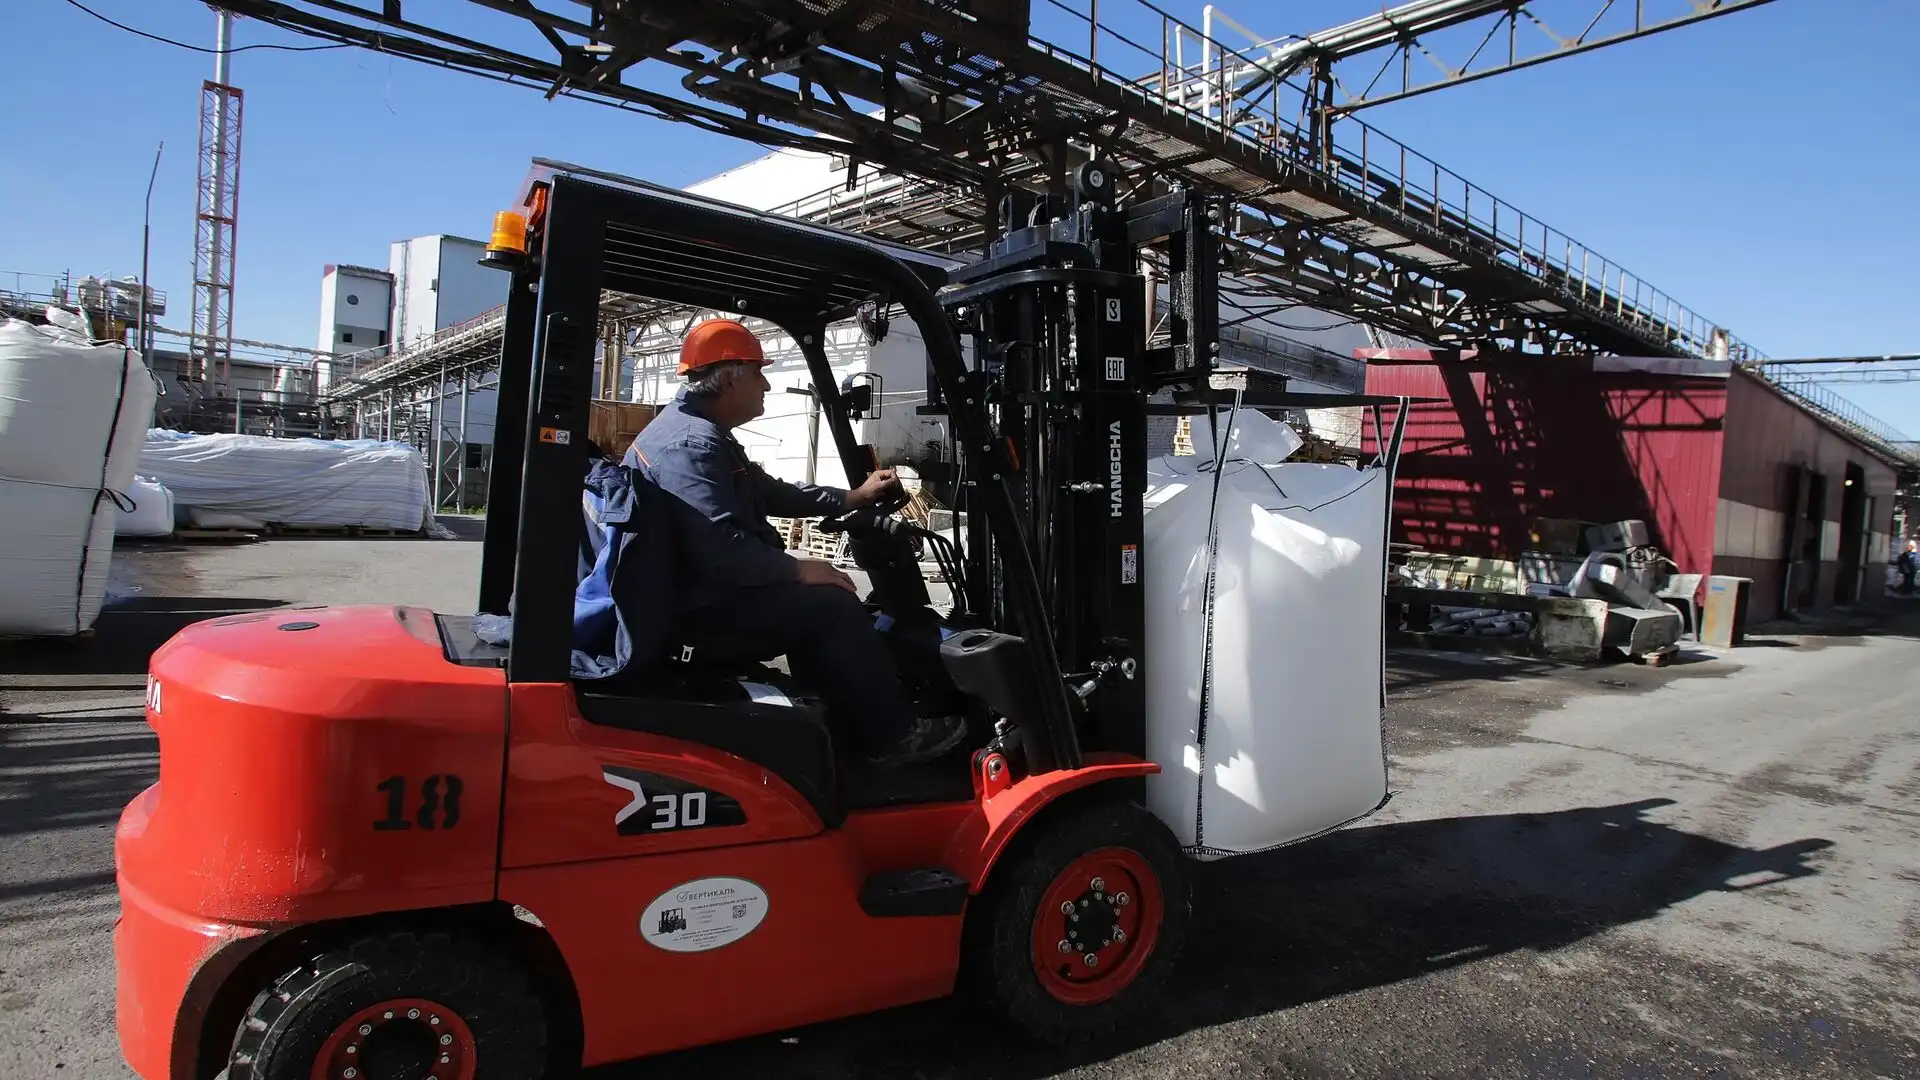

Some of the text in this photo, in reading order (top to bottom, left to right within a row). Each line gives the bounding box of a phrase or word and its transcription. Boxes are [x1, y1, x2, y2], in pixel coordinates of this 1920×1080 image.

[1107, 359, 1123, 380] EAC
[1109, 420, 1123, 517] HANGCHA
[373, 774, 463, 831] 18
[651, 792, 707, 830] 30
[688, 887, 736, 900] ВЕРТИКАЛЬ
